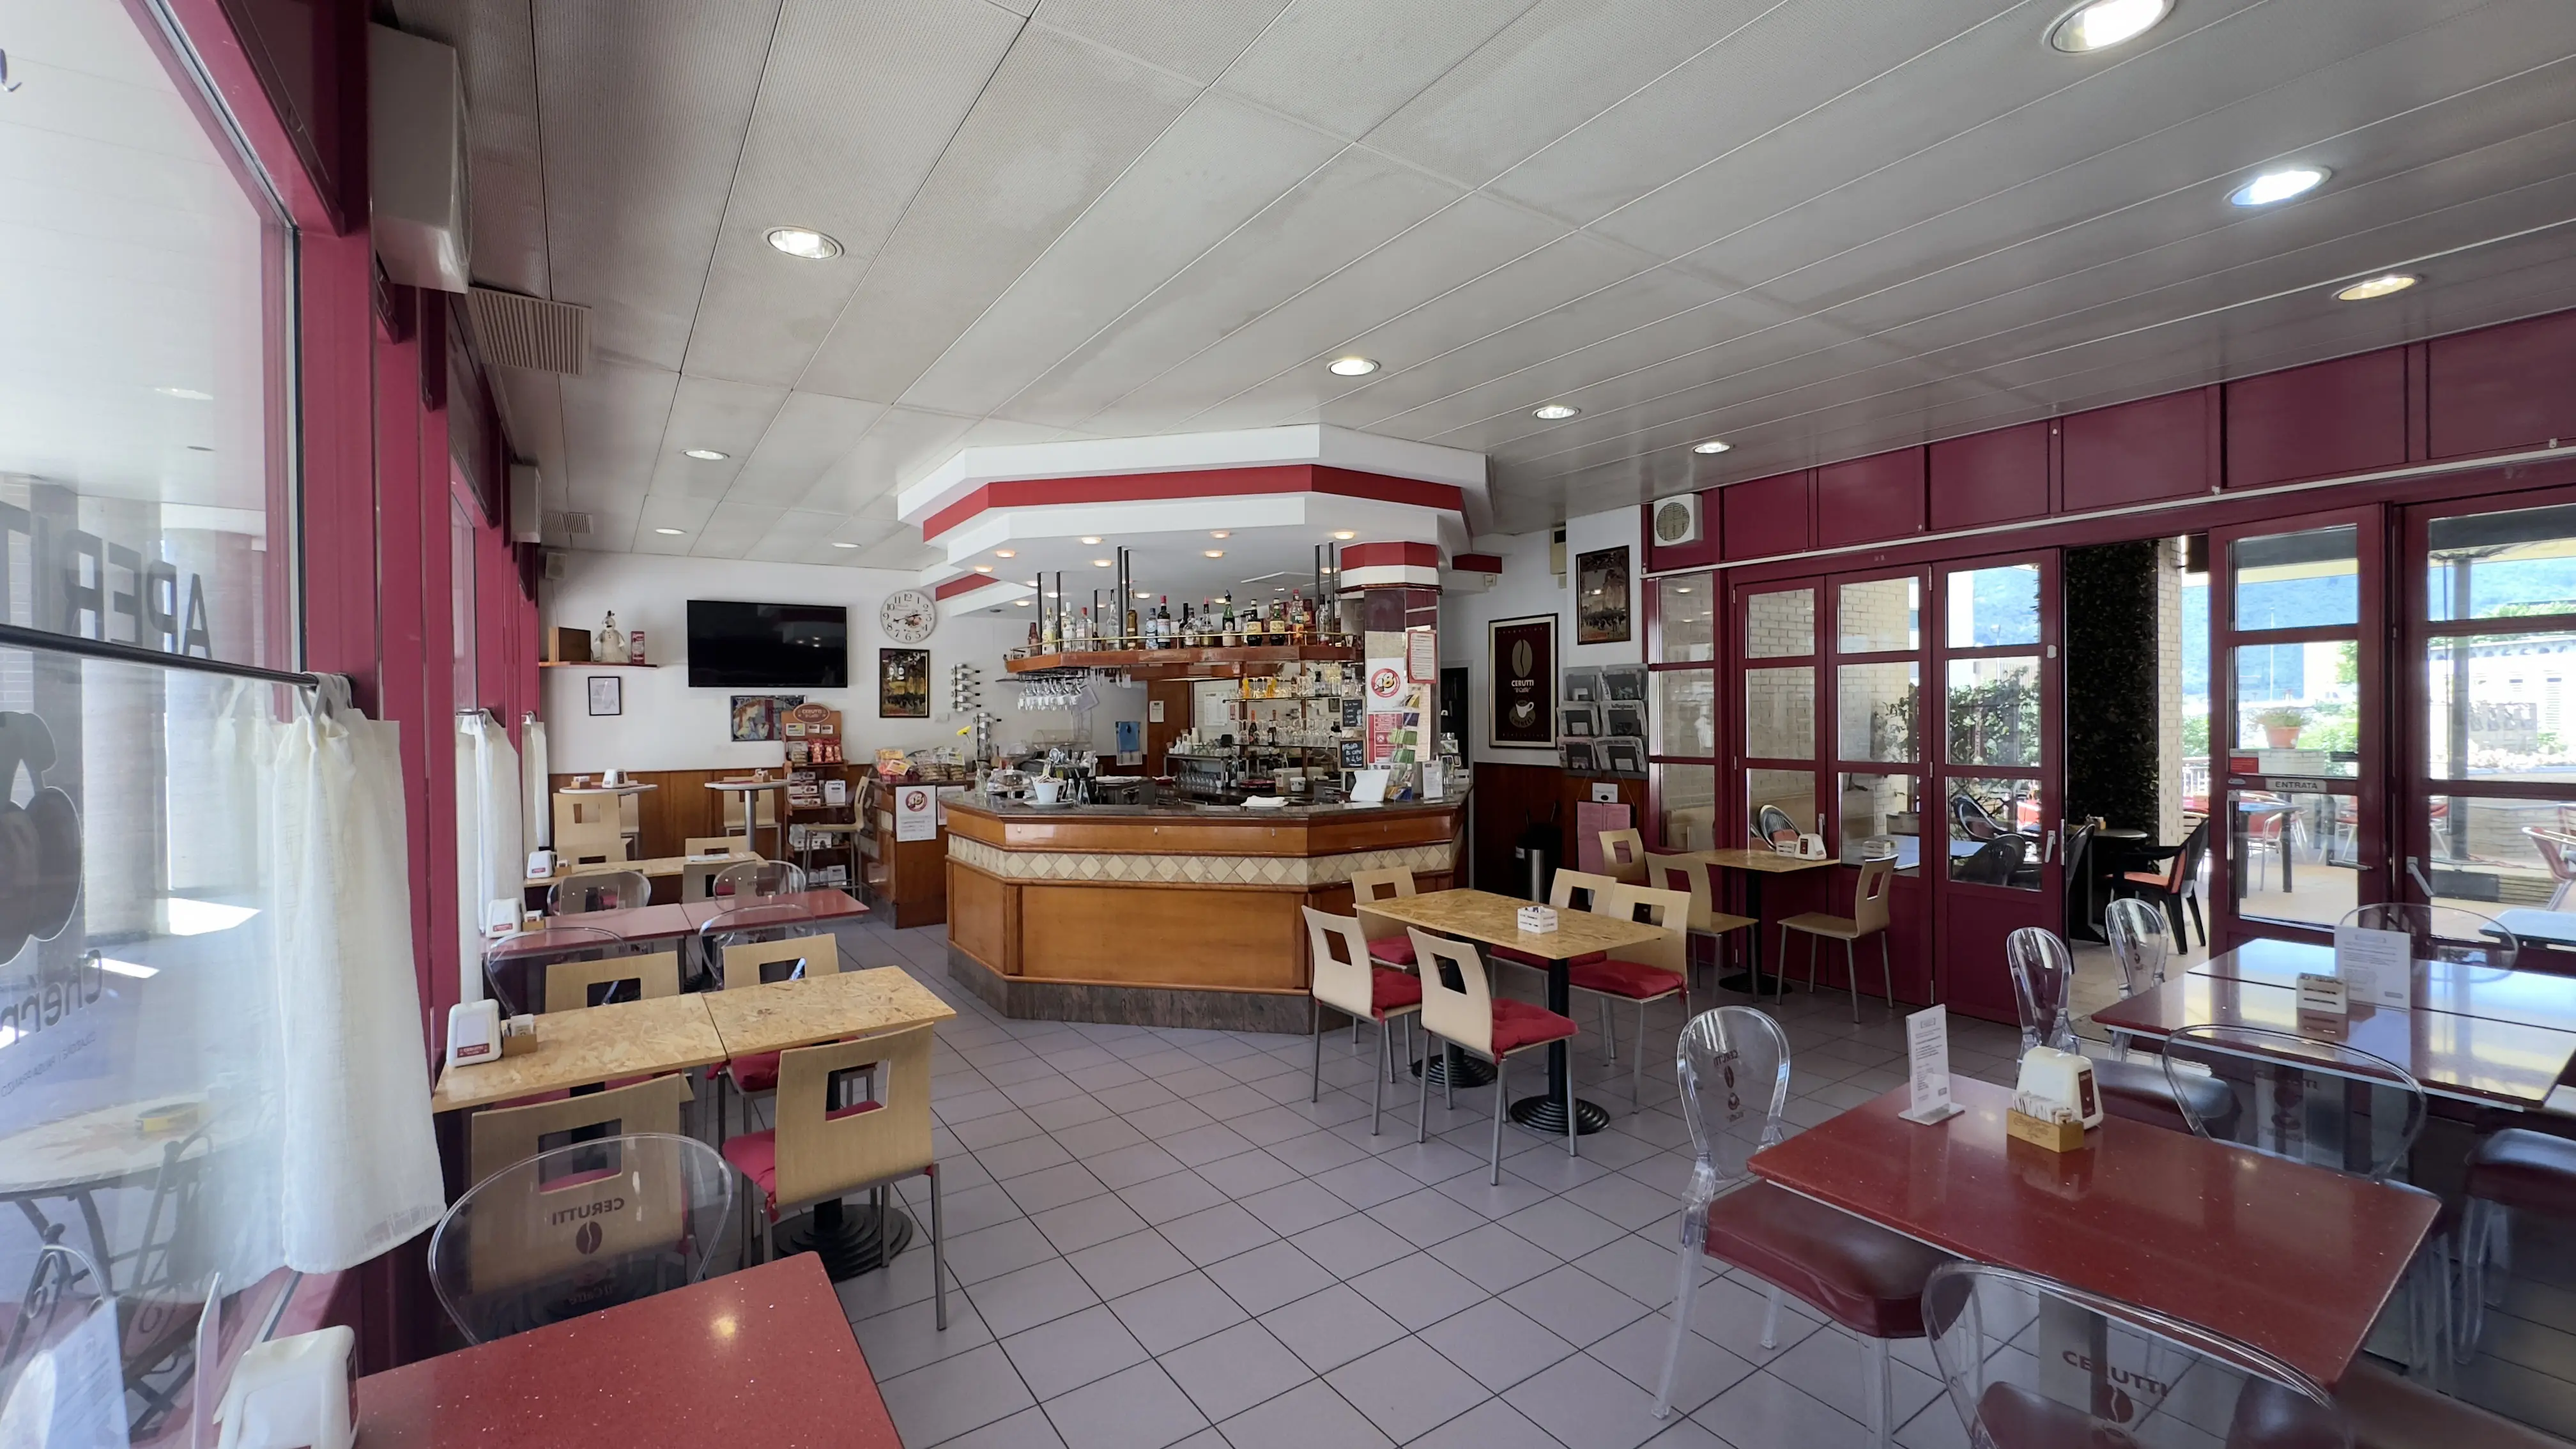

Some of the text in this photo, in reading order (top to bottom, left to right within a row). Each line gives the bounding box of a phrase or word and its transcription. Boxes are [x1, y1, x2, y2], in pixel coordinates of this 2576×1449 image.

[904, 593, 912, 601] 12
[923, 603, 929, 612] 2
[926, 613, 932, 622] 3
[895, 629, 900, 638] 7
[915, 631, 921, 639] 5
[2275, 781, 2318, 790] ENTRATA
